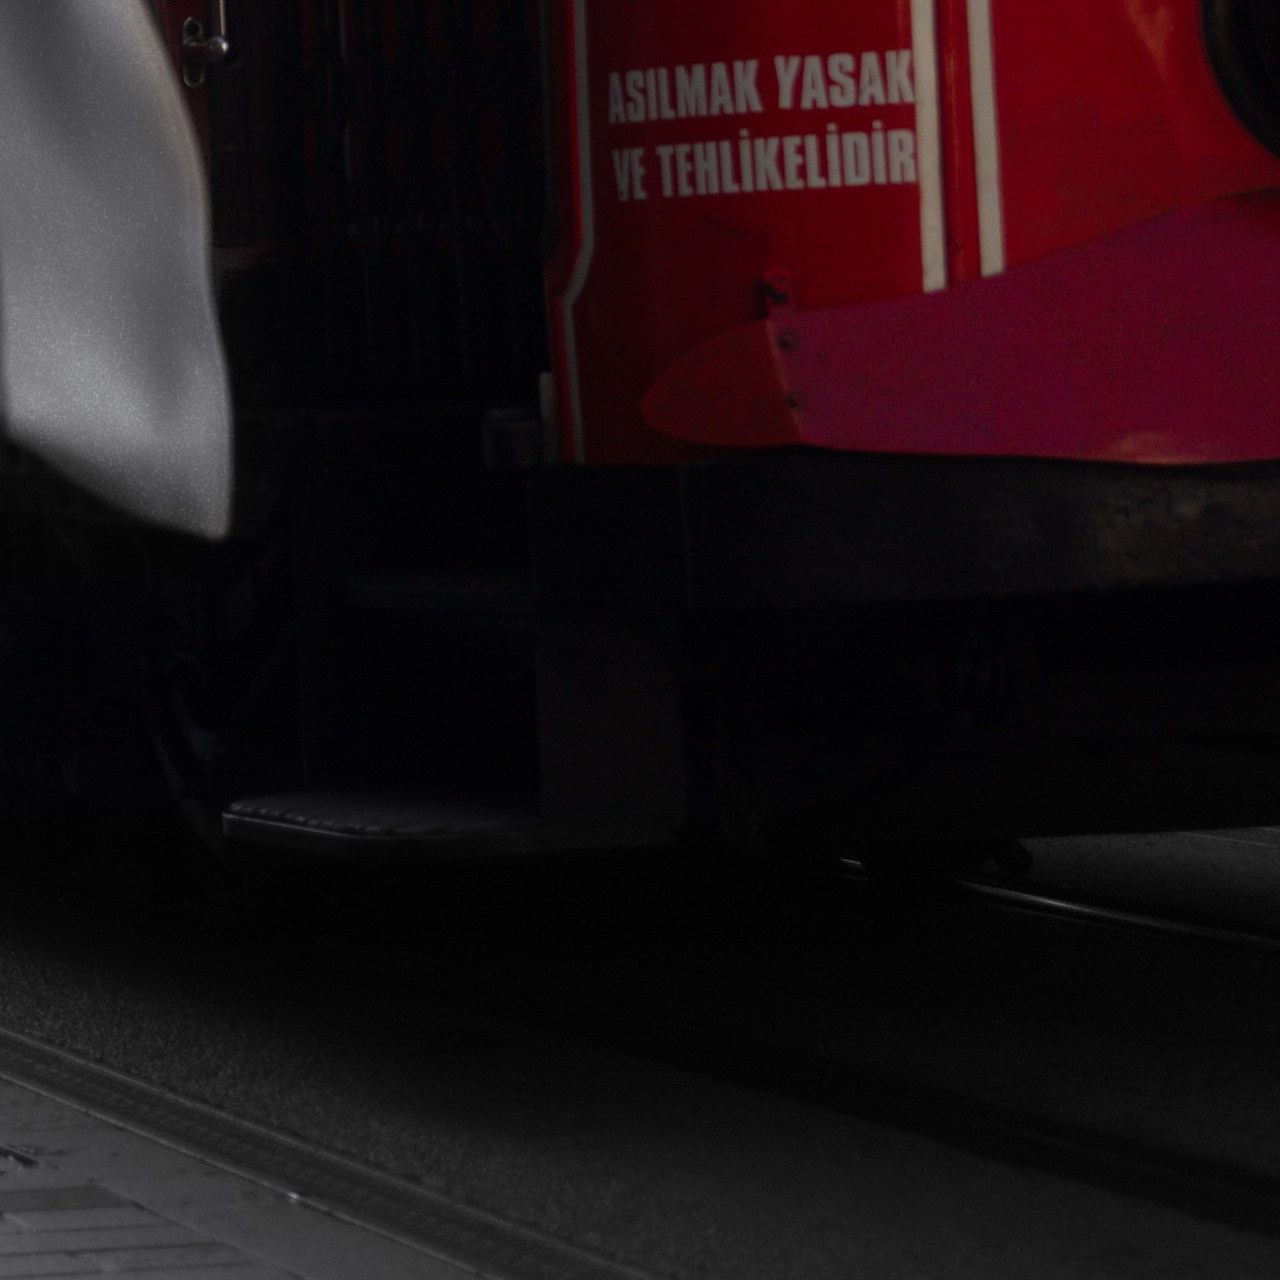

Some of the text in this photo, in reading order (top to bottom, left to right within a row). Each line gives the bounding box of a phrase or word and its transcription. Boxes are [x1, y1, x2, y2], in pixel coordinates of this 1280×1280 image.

[608, 49, 916, 124] ASILMAK YASAK
[611, 120, 917, 201] VE TEHLİKELİDİR
